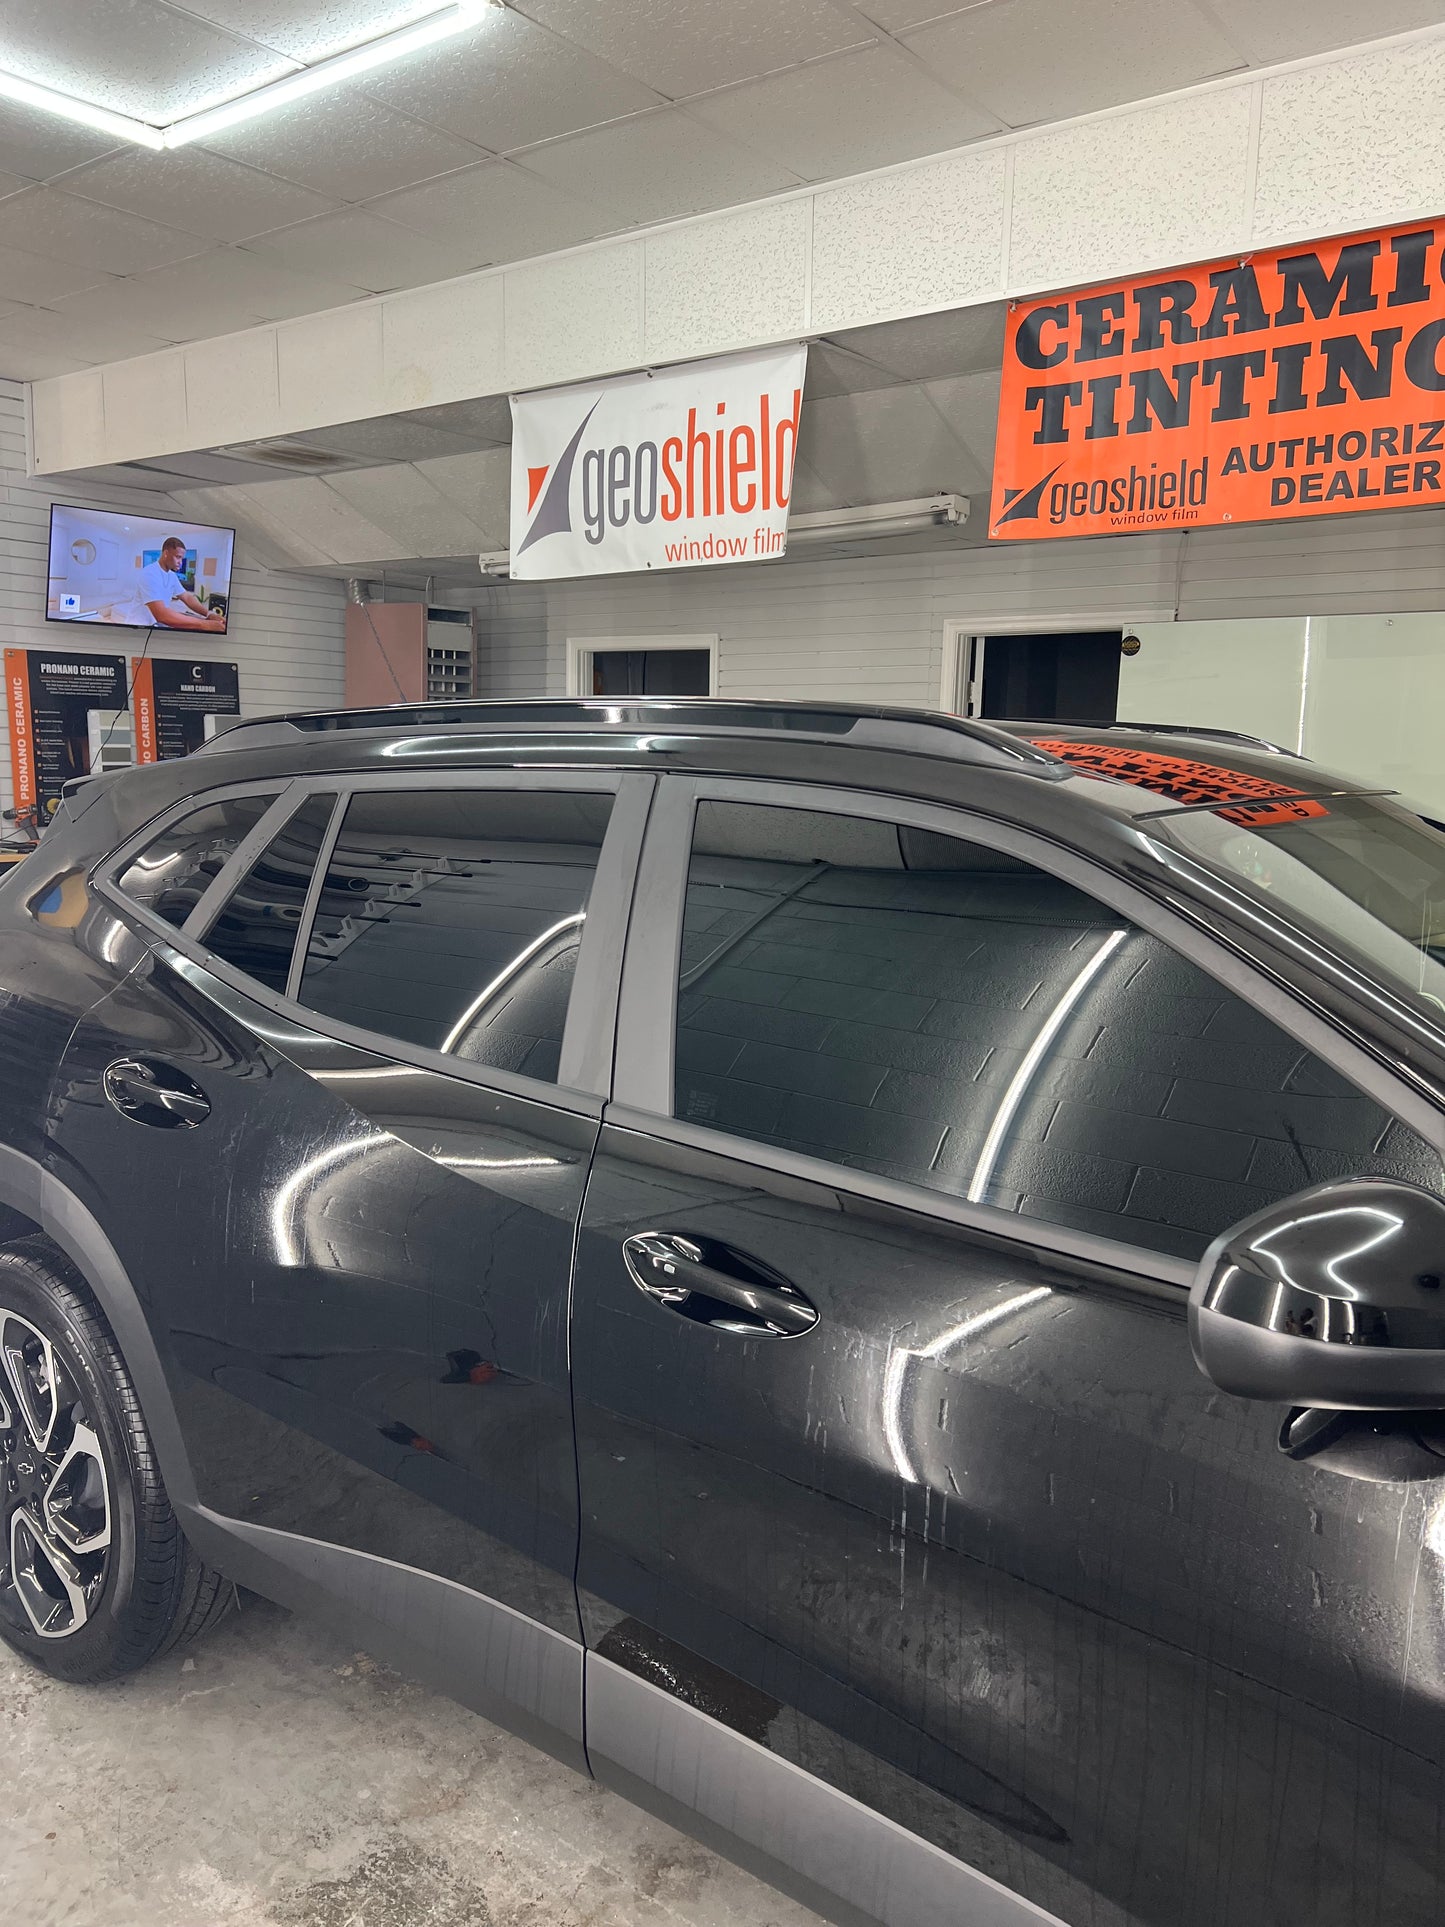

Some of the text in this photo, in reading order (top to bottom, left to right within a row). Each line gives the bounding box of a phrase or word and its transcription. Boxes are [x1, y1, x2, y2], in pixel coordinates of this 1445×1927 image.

[1015, 230, 1445, 369] CERAMI
[582, 388, 801, 545] geoshield
[1221, 420, 1445, 477] AUTHORIZ
[1049, 456, 1209, 525] geoshield
[1270, 460, 1442, 507] DEALER
[1110, 508, 1199, 526] window film
[664, 527, 786, 563] window film
[40, 663, 115, 677] PRONANO CERAMIC
[13, 677, 30, 800] PRONANO CERAMIC
[140, 698, 151, 748] CARBON
